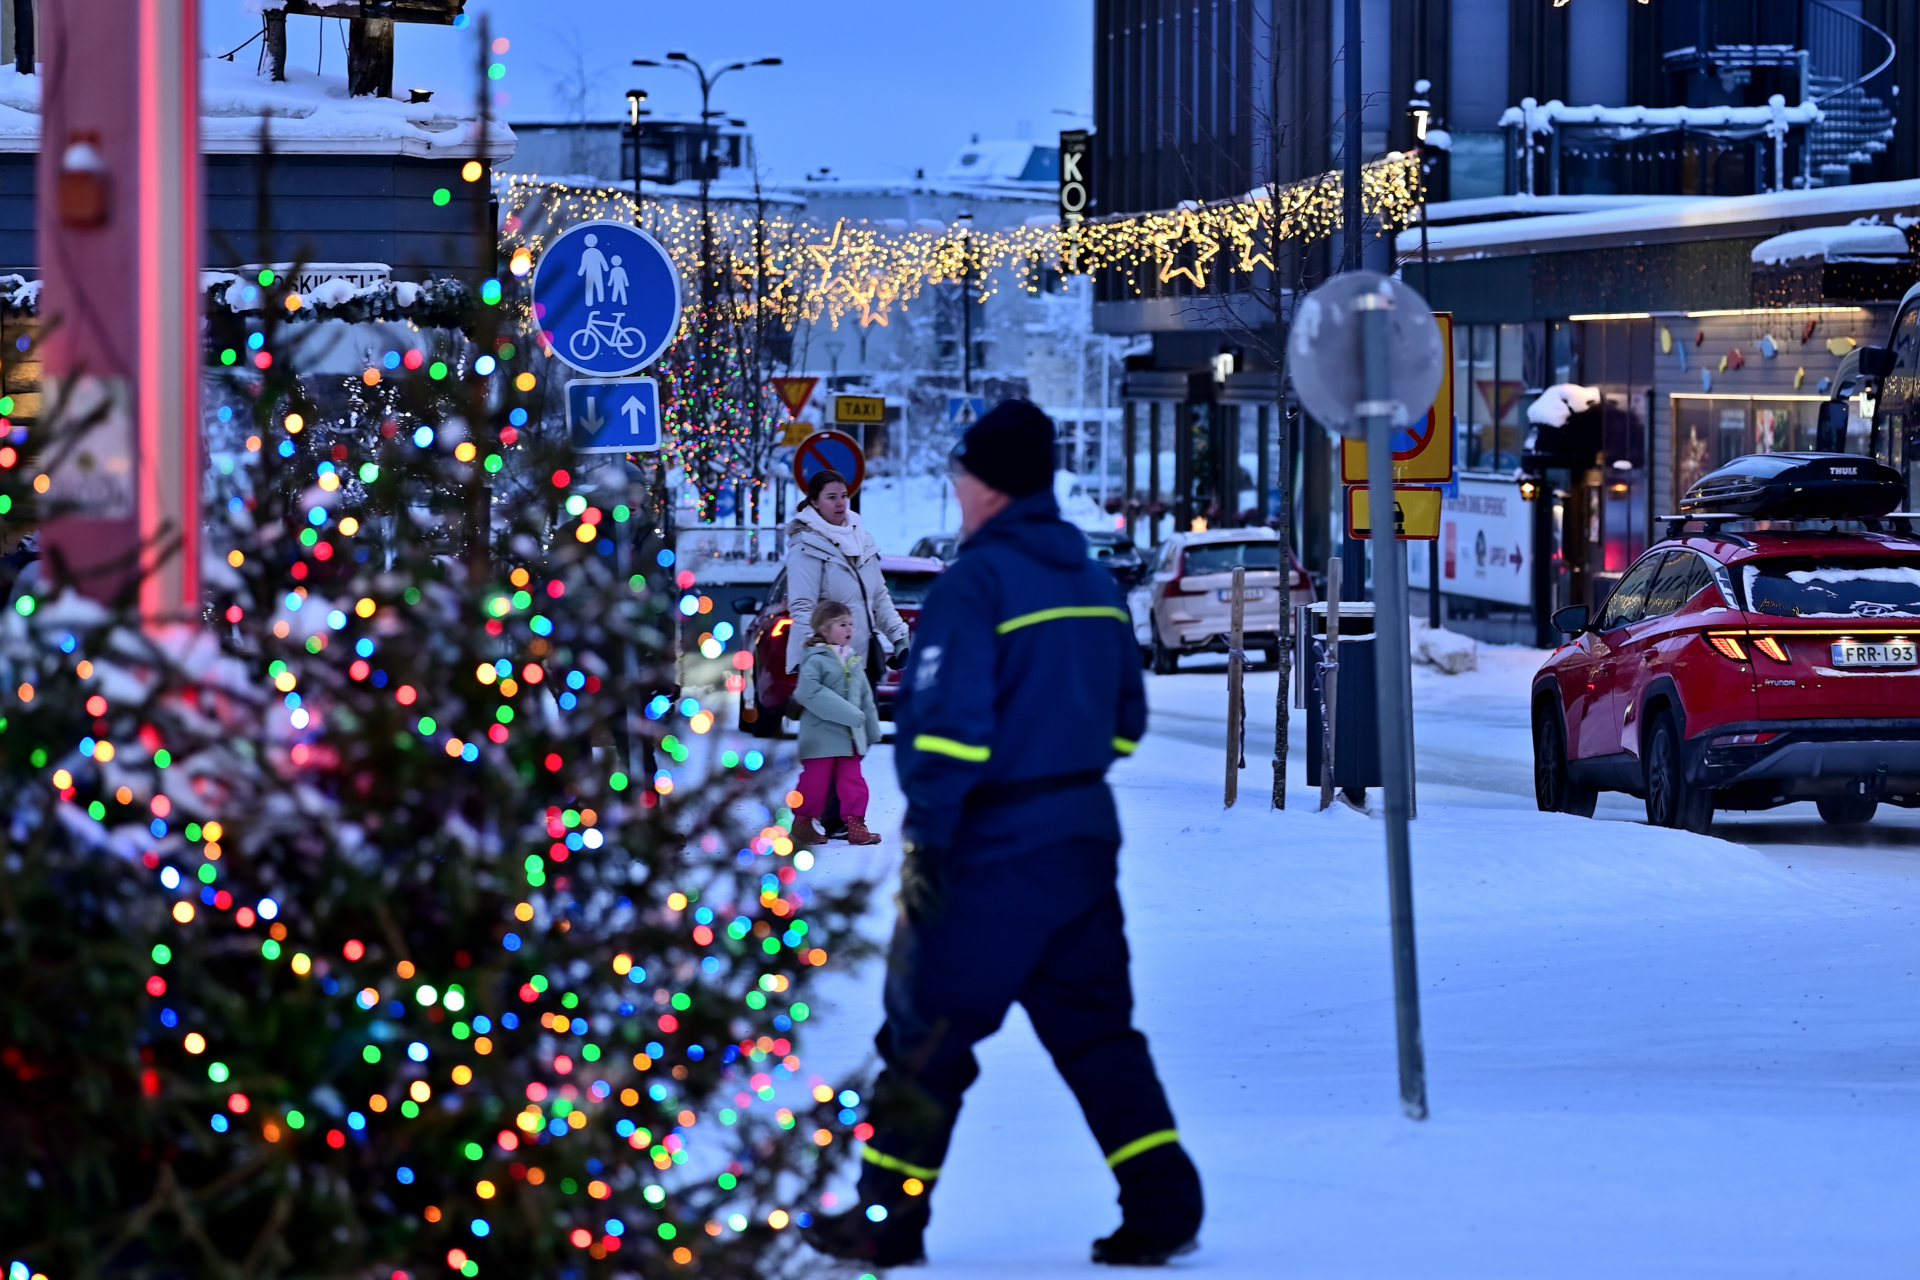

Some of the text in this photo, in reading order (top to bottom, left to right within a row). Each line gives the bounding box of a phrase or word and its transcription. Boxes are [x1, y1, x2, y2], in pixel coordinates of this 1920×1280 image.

[844, 402, 876, 416] TAXI
[1829, 467, 1858, 475] THULE
[1846, 646, 1913, 662] FRR-193
[1764, 679, 1796, 687] HYUNDAI
